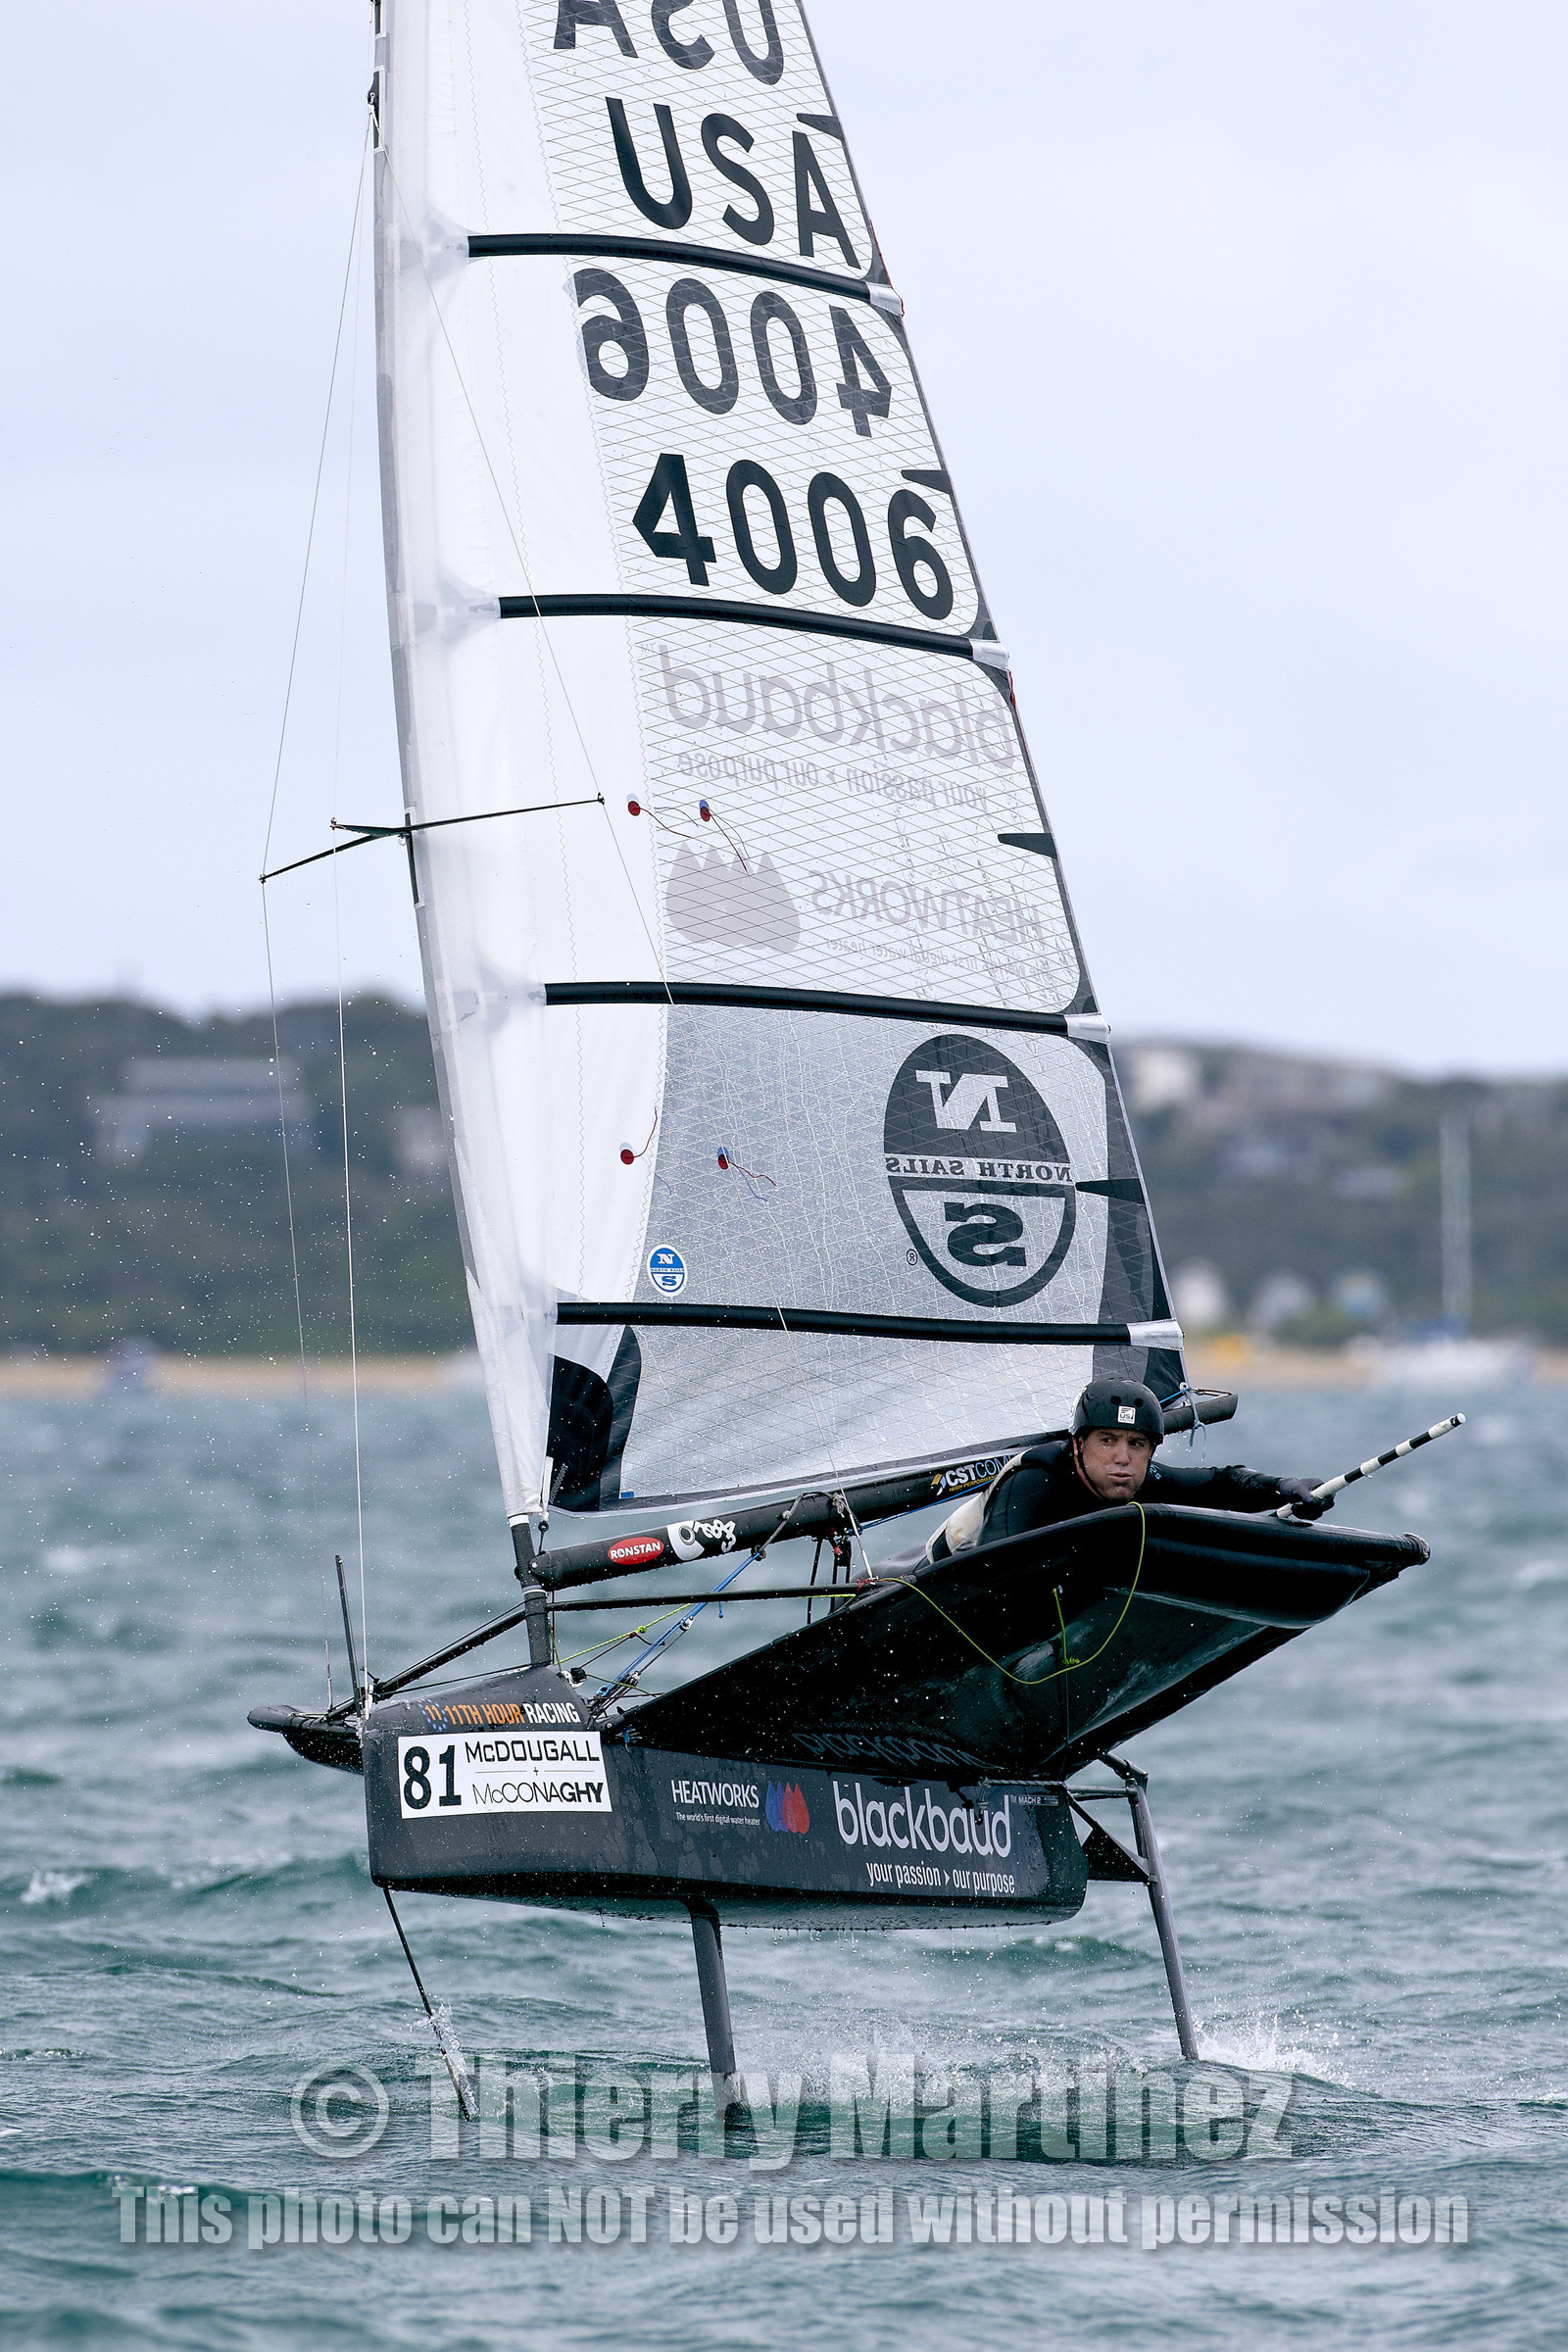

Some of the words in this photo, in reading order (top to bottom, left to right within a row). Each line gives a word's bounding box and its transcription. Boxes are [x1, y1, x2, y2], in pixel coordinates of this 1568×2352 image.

[605, 96, 861, 270] USA
[632, 453, 955, 621] 4006
[657, 1253, 675, 1264] N
[662, 1276, 677, 1286] S
[610, 1542, 662, 1559] RONSTAN
[444, 1704, 484, 1725] 11TH
[481, 1703, 526, 1725] HOUR
[522, 1702, 581, 1724] RACING
[465, 1740, 600, 1763] McDOUGALL
[404, 1744, 462, 1809] 81
[472, 1782, 604, 1805] McCONAGHY
[670, 1780, 760, 1809] HEATWORKS
[675, 1812, 686, 1821] The
[686, 1813, 704, 1822] world's
[705, 1813, 715, 1823] first
[715, 1814, 730, 1825] digital
[745, 1816, 760, 1826] heater
[832, 1781, 1010, 1858] blackbaud
[865, 1862, 893, 1887] your
[894, 1863, 942, 1889] passion
[952, 1868, 971, 1889] our
[973, 1870, 1015, 1897] purpose
